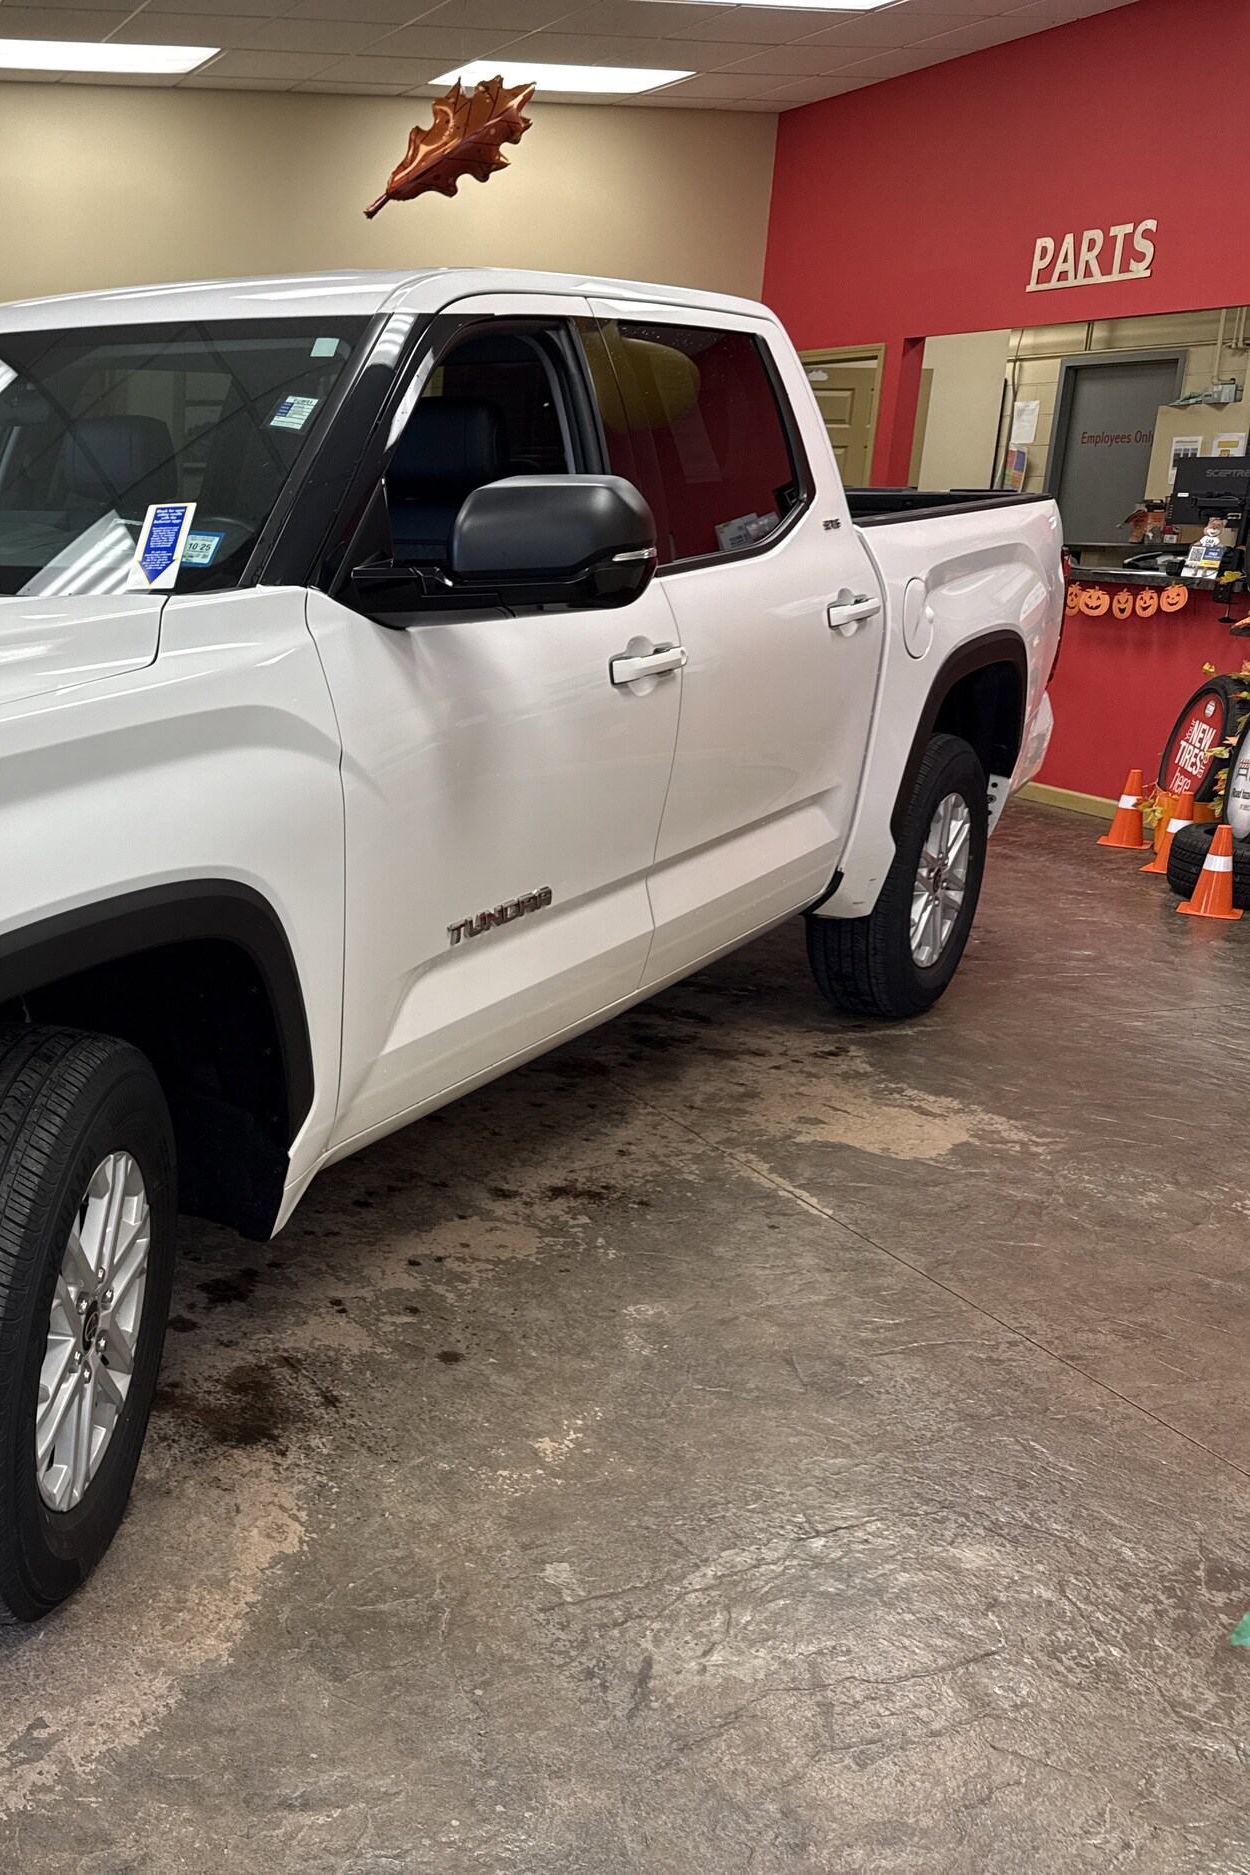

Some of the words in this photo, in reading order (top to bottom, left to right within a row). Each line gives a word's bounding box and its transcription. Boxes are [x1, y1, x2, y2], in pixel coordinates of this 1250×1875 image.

[1028, 219, 1158, 288] PARTS
[1081, 431, 1132, 447] Employees
[189, 542, 198, 550] 10
[200, 543, 211, 551] 25
[1189, 720, 1217, 751] NEW
[1174, 740, 1204, 776] TIRES
[1169, 766, 1192, 795] here
[446, 886, 553, 945] TUNDRA
